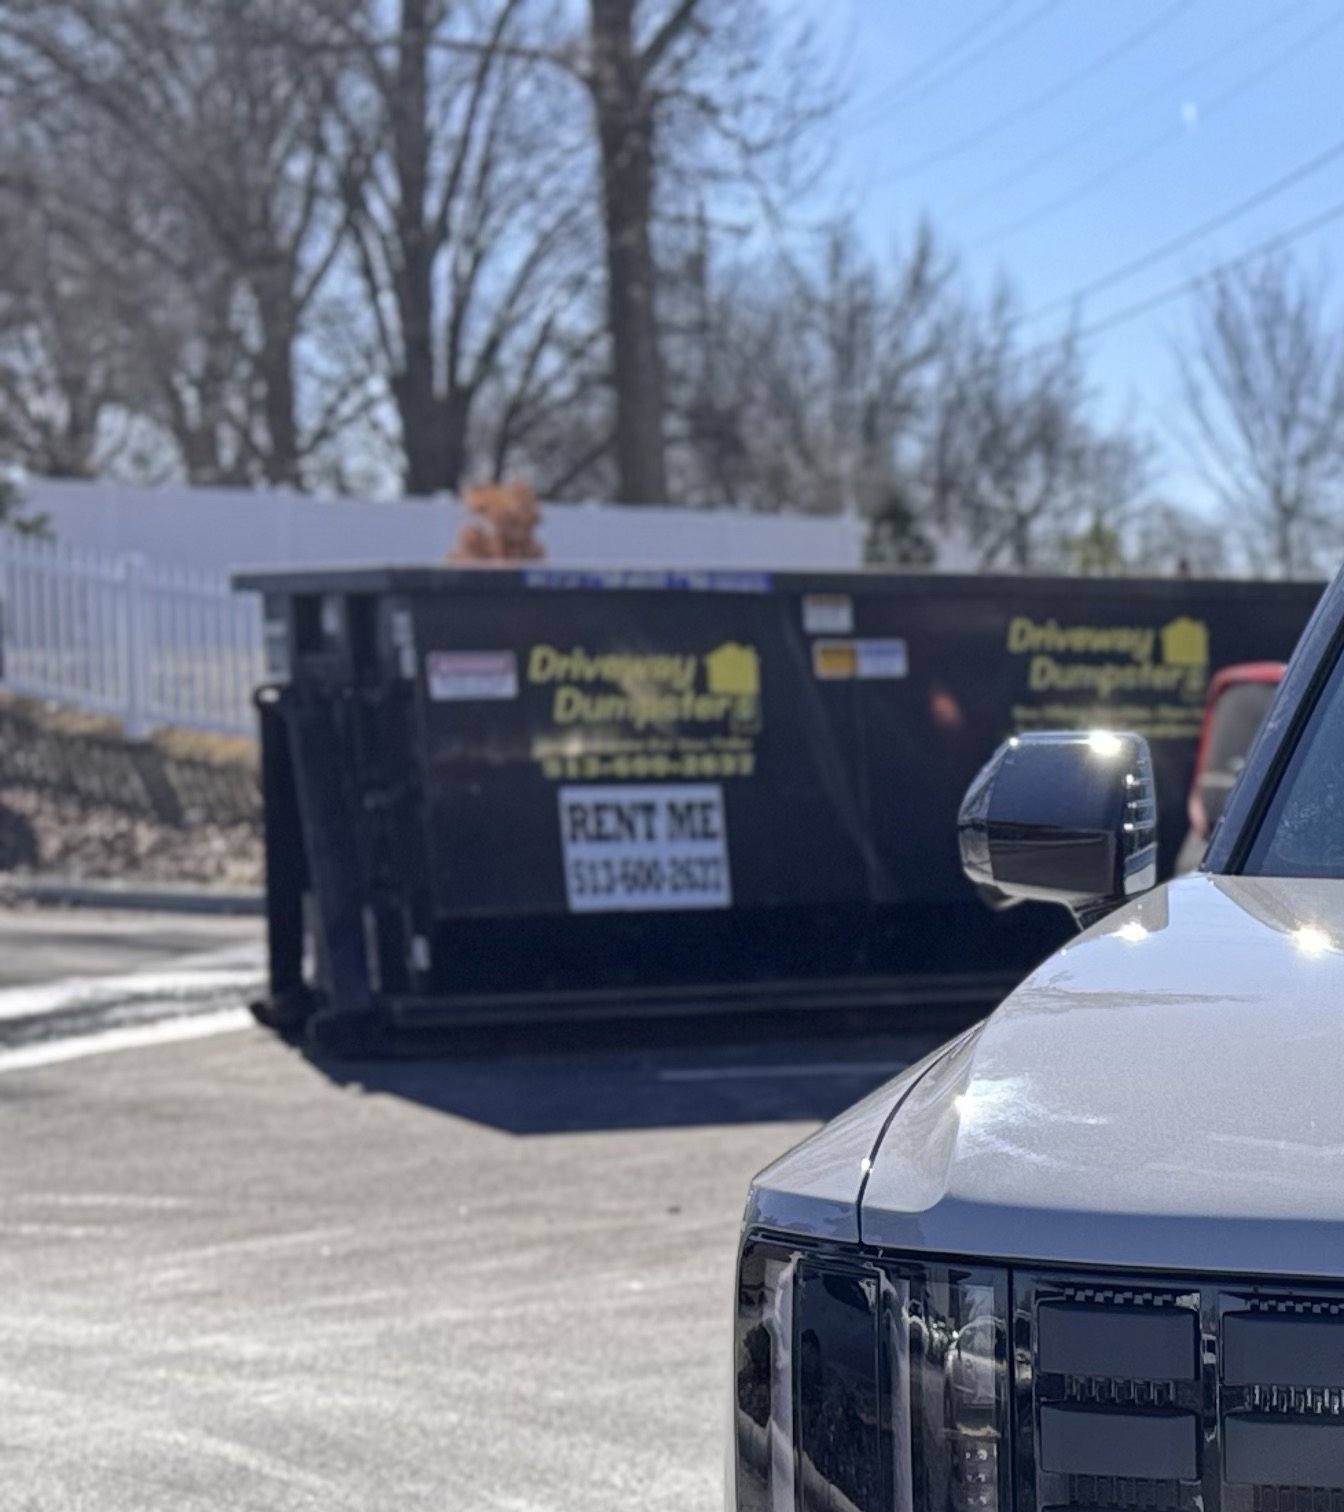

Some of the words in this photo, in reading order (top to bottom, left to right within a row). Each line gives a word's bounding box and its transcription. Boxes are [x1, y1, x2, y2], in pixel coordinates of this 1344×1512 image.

[527, 645, 696, 690] Driveway
[569, 801, 656, 844] RENT
[666, 800, 719, 840] ME
